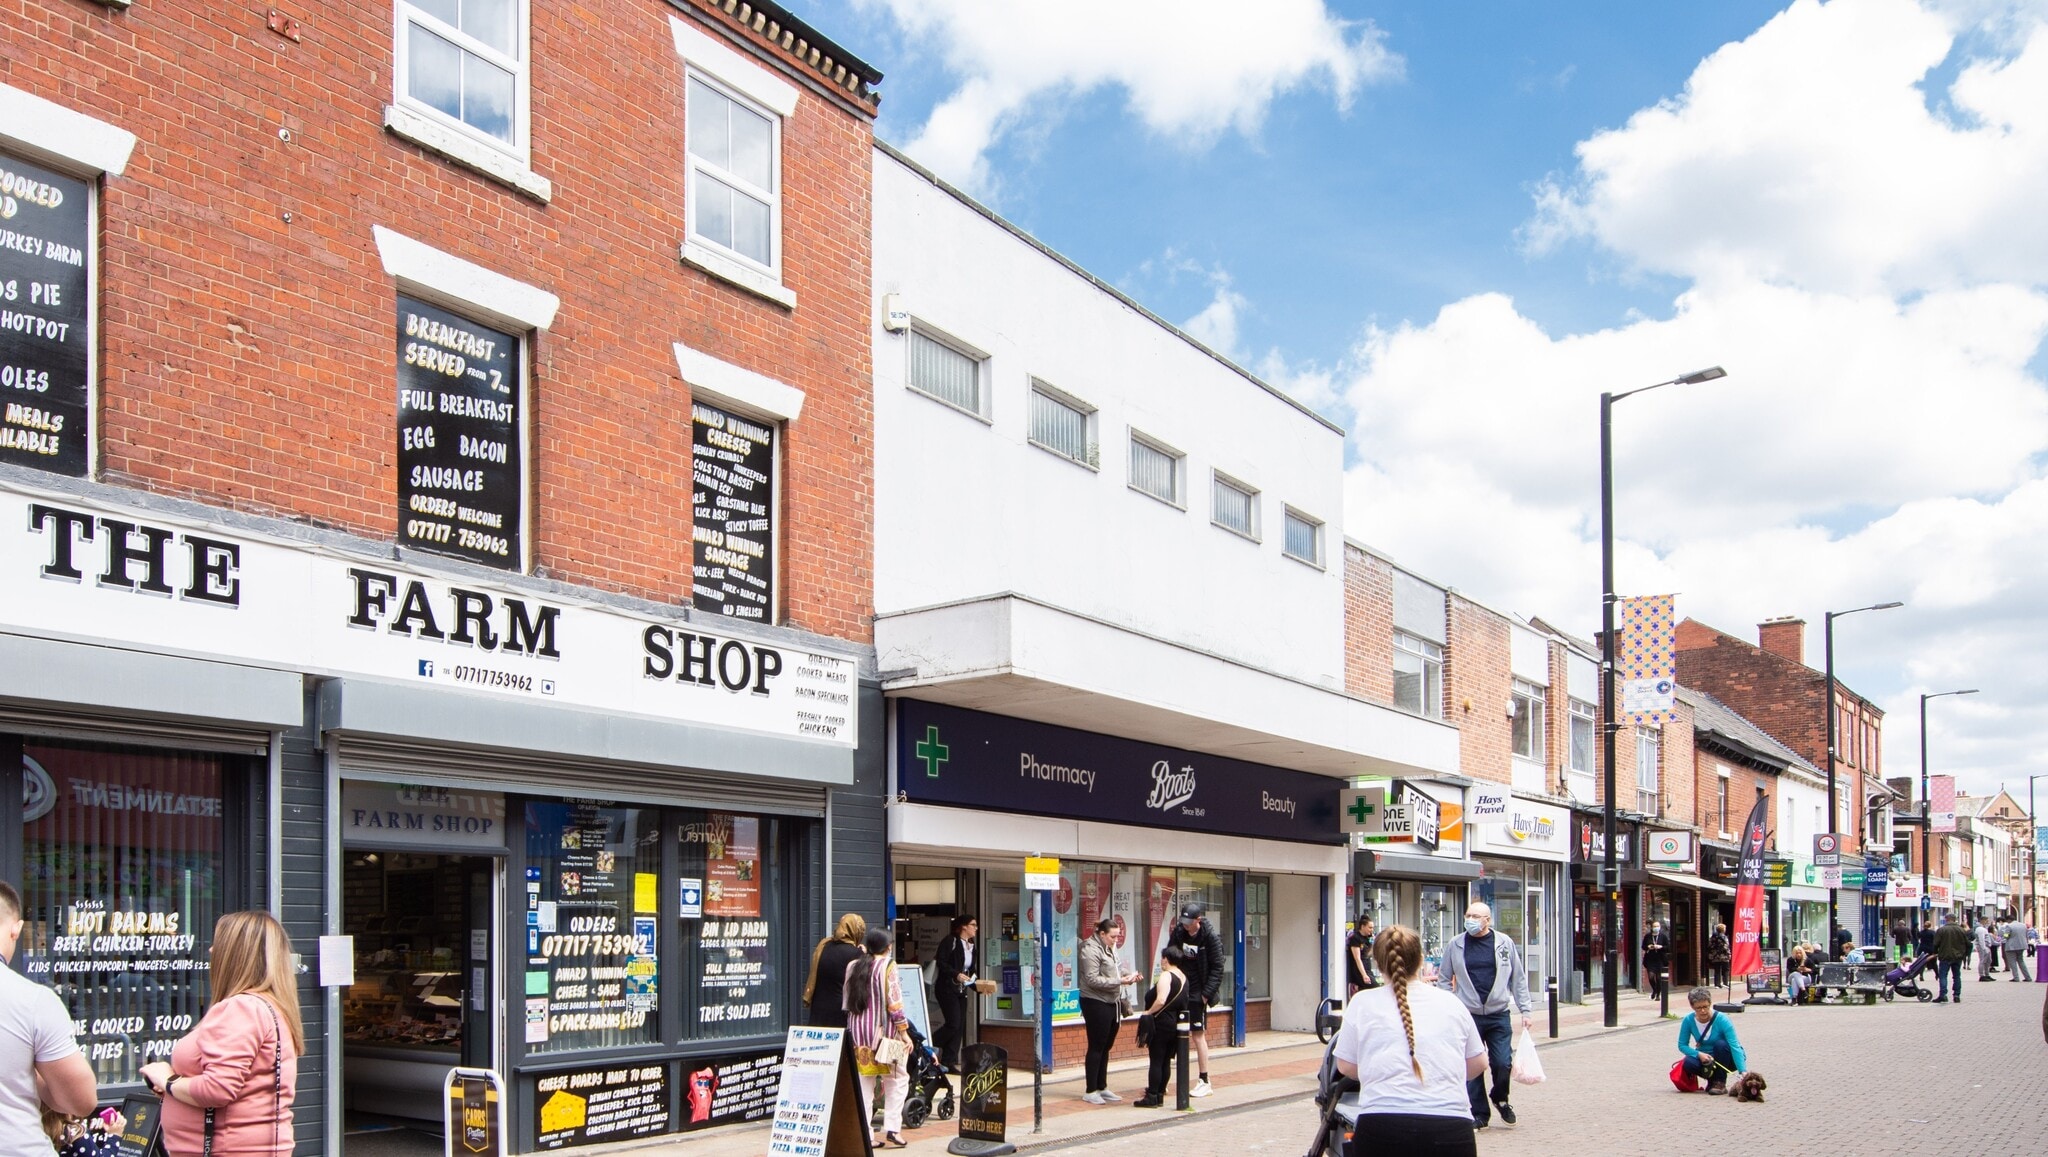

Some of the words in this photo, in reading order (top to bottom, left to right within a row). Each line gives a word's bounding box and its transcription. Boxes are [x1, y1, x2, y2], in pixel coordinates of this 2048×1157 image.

[45, 241, 82, 266] BARM
[31, 282, 61, 306] PIE
[1, 310, 69, 342] HOTPOT
[406, 313, 495, 361] BREAKFAST
[405, 343, 466, 378] SERVED
[401, 389, 434, 412] FULL
[440, 393, 514, 423] BREAKFAST
[6, 403, 64, 432] MEALS
[692, 404, 725, 429] AWARD
[727, 417, 770, 446] WINNING
[0, 427, 59, 455] ILABLE
[403, 426, 435, 451] EGG
[460, 435, 507, 464] BACON
[706, 428, 752, 456] CHEESES
[411, 465, 484, 492] SAUSAGE
[410, 494, 457, 519] ORDERS
[458, 506, 502, 528] WELCOME
[695, 507, 711, 519] KICK
[751, 503, 766, 516] BLUE
[725, 520, 748, 532] STICKY
[748, 518, 769, 531] TOFFEE
[692, 525, 724, 547] AWARD
[726, 534, 765, 559] WINNING
[27, 503, 240, 610] THE
[705, 546, 750, 571] SAUSAGE
[722, 604, 734, 616] OLD
[736, 605, 763, 618] ENGLISH
[346, 567, 561, 662] FARM
[642, 624, 783, 697] SHOP
[455, 665, 532, 691] 07717753962
[797, 666, 823, 679] COOKED
[795, 686, 816, 697] BACON
[799, 722, 837, 737] CHICKENS
[1020, 752, 1096, 793] Pharmacy
[1146, 760, 1196, 812] Boots
[1262, 791, 1296, 819] Beauty
[1474, 804, 1506, 815] Travel
[1478, 795, 1503, 806] Hays
[1182, 806, 1194, 816] Since
[1194, 807, 1206, 817] 1849
[352, 809, 424, 830] FARM
[433, 814, 493, 834] SHOP
[1513, 813, 1532, 833] Hays
[1533, 816, 1555, 836] Travel
[70, 911, 106, 934] HOT
[111, 911, 179, 934] BARMS
[570, 916, 616, 932] ORDERS
[702, 922, 719, 937] BIN
[724, 922, 739, 937] LID
[741, 922, 768, 937] BARM
[92, 935, 144, 951] CHICKEN
[149, 934, 194, 951] TURKEY
[27, 961, 50, 973] KIDS
[54, 960, 90, 974] CHICKEN
[92, 960, 128, 973] POPCORN
[172, 959, 193, 970] CHIPS
[555, 968, 587, 981] AWARD
[591, 967, 628, 980] WINNING
[706, 963, 722, 974] FULL
[725, 962, 761, 973] BREAKFAST
[555, 984, 588, 1000] CHEESE
[598, 984, 620, 997] SAUS
[1058, 991, 1070, 1001] HEY
[550, 1002, 569, 1011] CHEESE
[570, 1001, 588, 1010] BOARDS
[700, 1006, 724, 1022] TRIPE
[726, 1005, 750, 1020] SOLD
[751, 1003, 771, 1018] HERE
[1054, 1000, 1078, 1011] SUMMER
[92, 1017, 144, 1035] COOKED
[155, 1014, 192, 1032] FOOD
[550, 1015, 559, 1033] 6
[92, 1042, 124, 1060] PIES
[538, 1075, 568, 1092] CHEESE
[570, 1072, 603, 1089] BOARDS
[605, 1070, 627, 1084] MADE
[630, 1068, 640, 1081] TO
[640, 1067, 662, 1080] ORDER
[779, 1110, 798, 1120] COOKED
[797, 1102, 811, 1110] COLD
[812, 1103, 826, 1112] PIES
[465, 1108, 485, 1128] CARRS
[962, 1118, 986, 1132] SERVED
[986, 1120, 1003, 1134] HERE
[800, 1123, 823, 1135] FILLETS
[772, 1142, 790, 1152] PIZZA
[795, 1144, 821, 1156] WAFFLES
